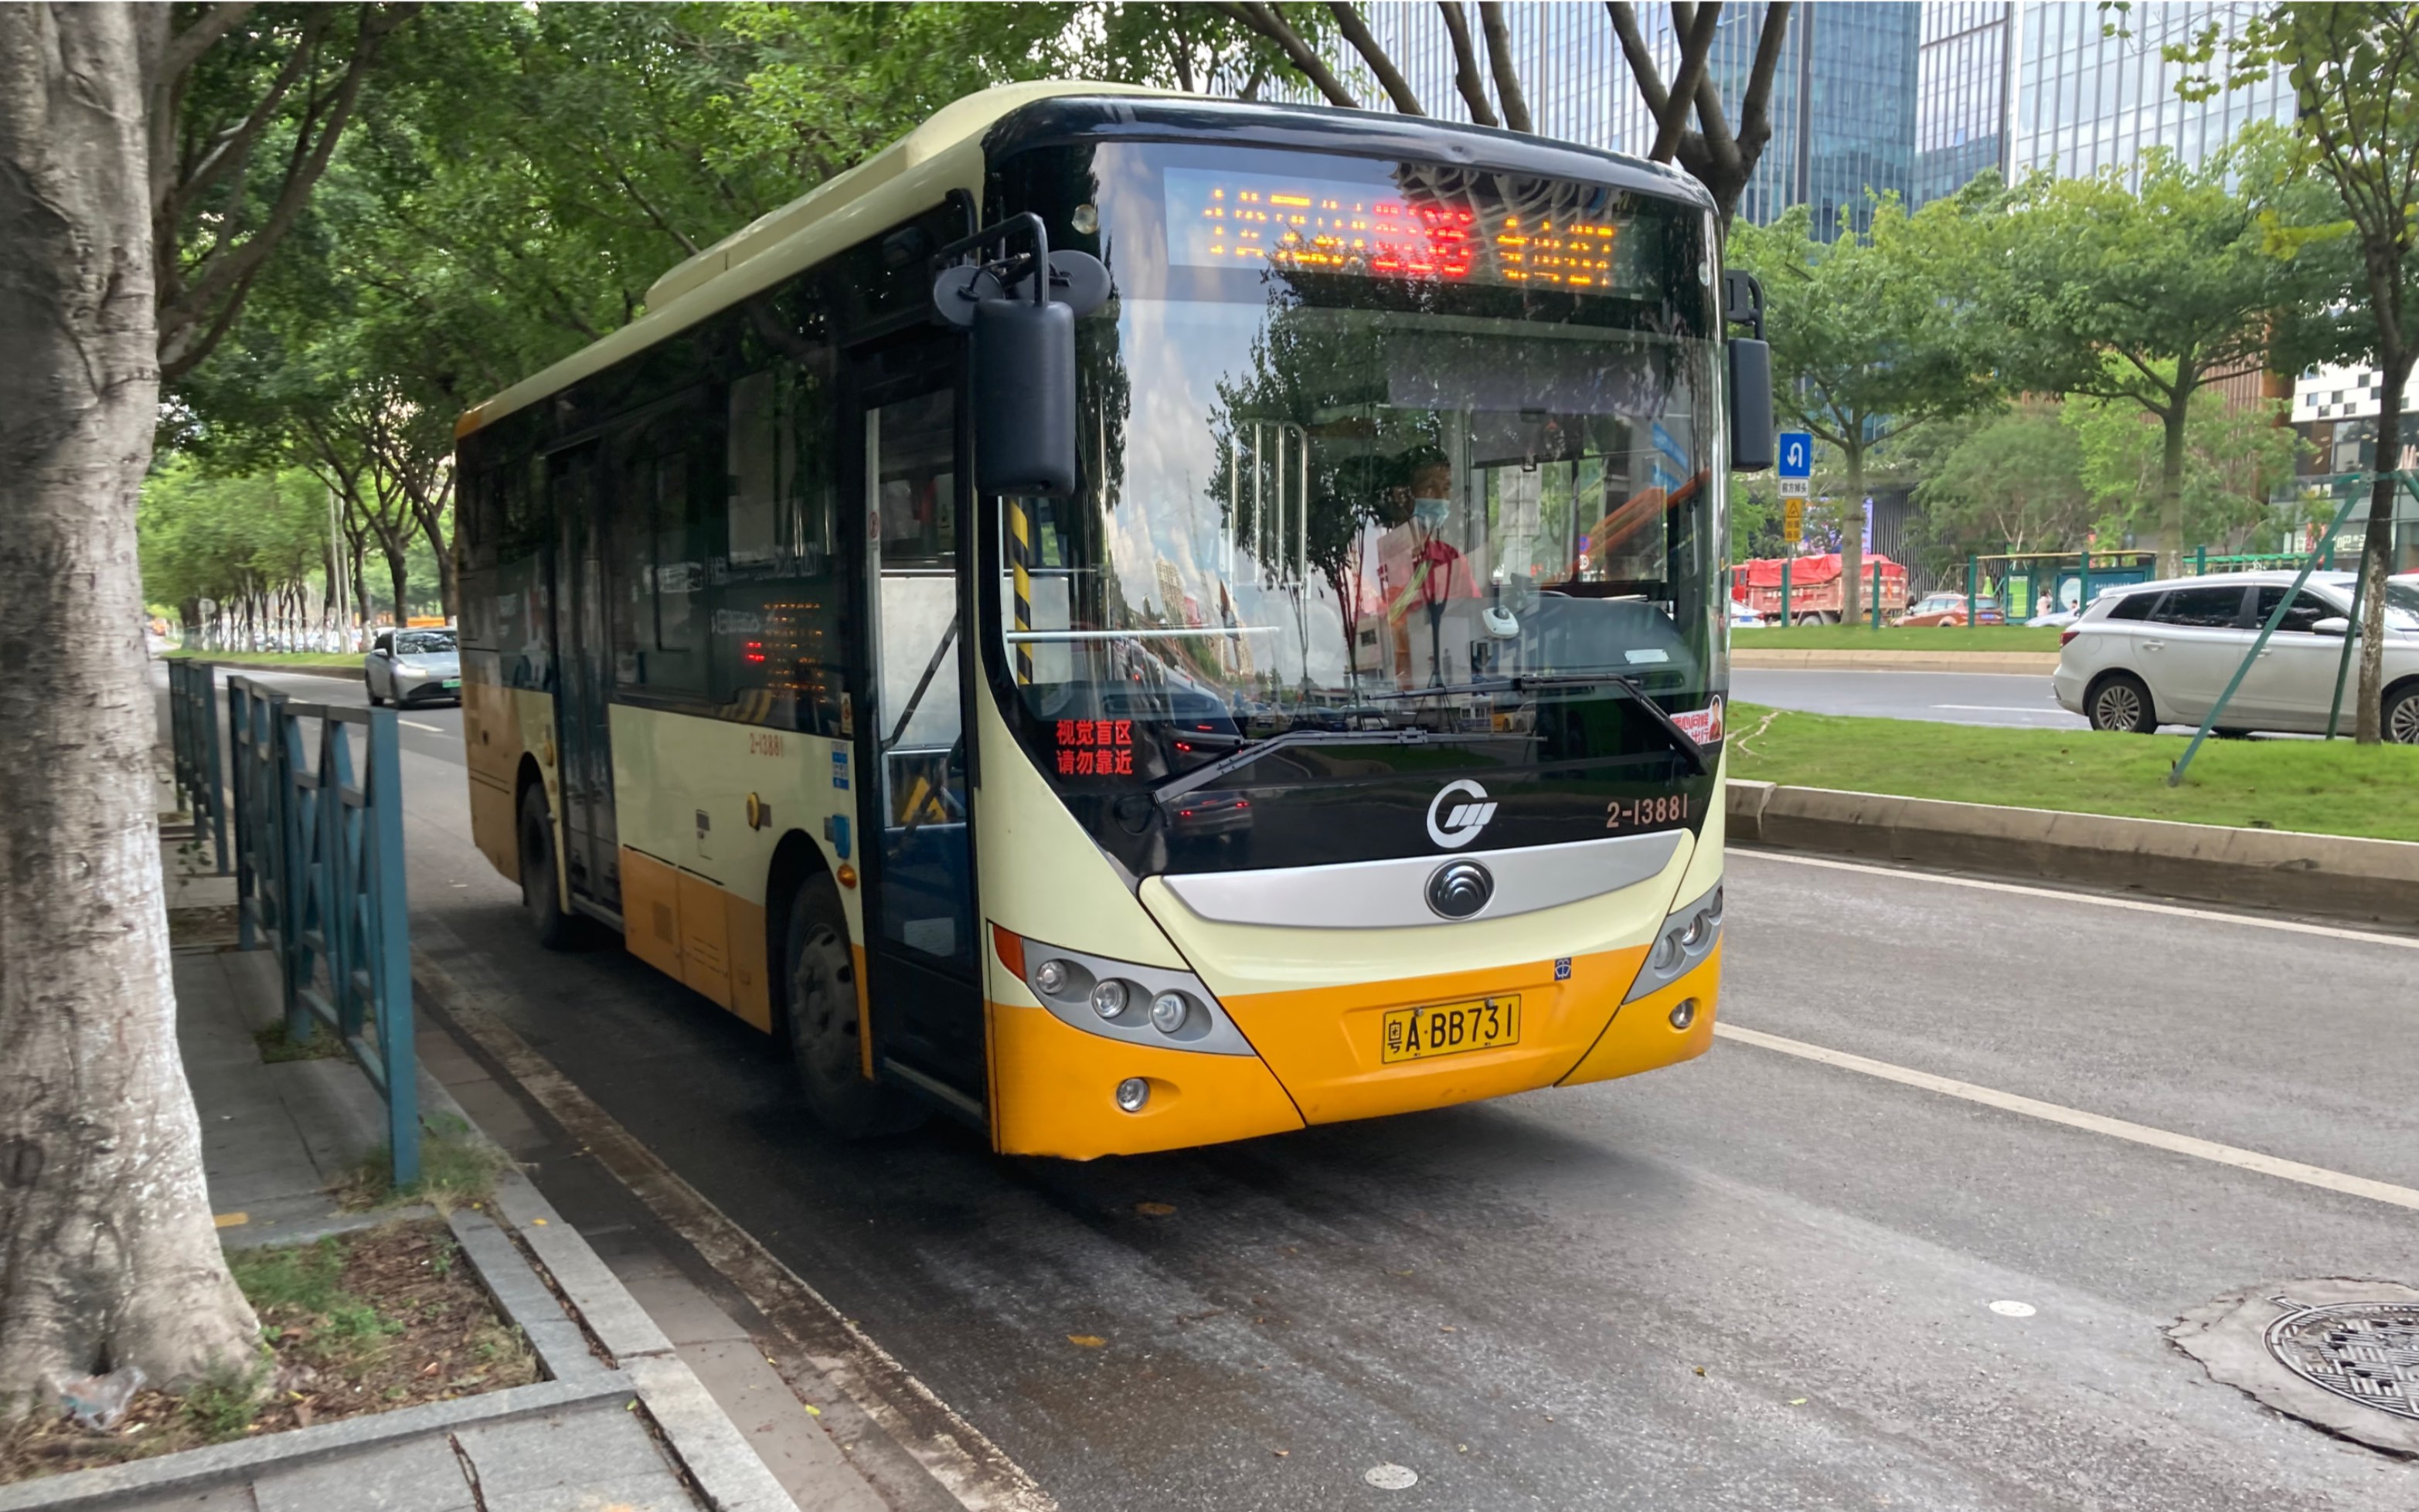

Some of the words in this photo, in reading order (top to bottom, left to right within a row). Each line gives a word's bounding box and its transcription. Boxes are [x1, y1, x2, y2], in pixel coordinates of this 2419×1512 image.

[1781, 481, 1808, 494] 前方掉头
[749, 732, 784, 758] 2-13881
[1056, 719, 1132, 746] 视觉盲区
[1056, 749, 1133, 774] 请勿靠近
[1606, 793, 1688, 828] 2-13881
